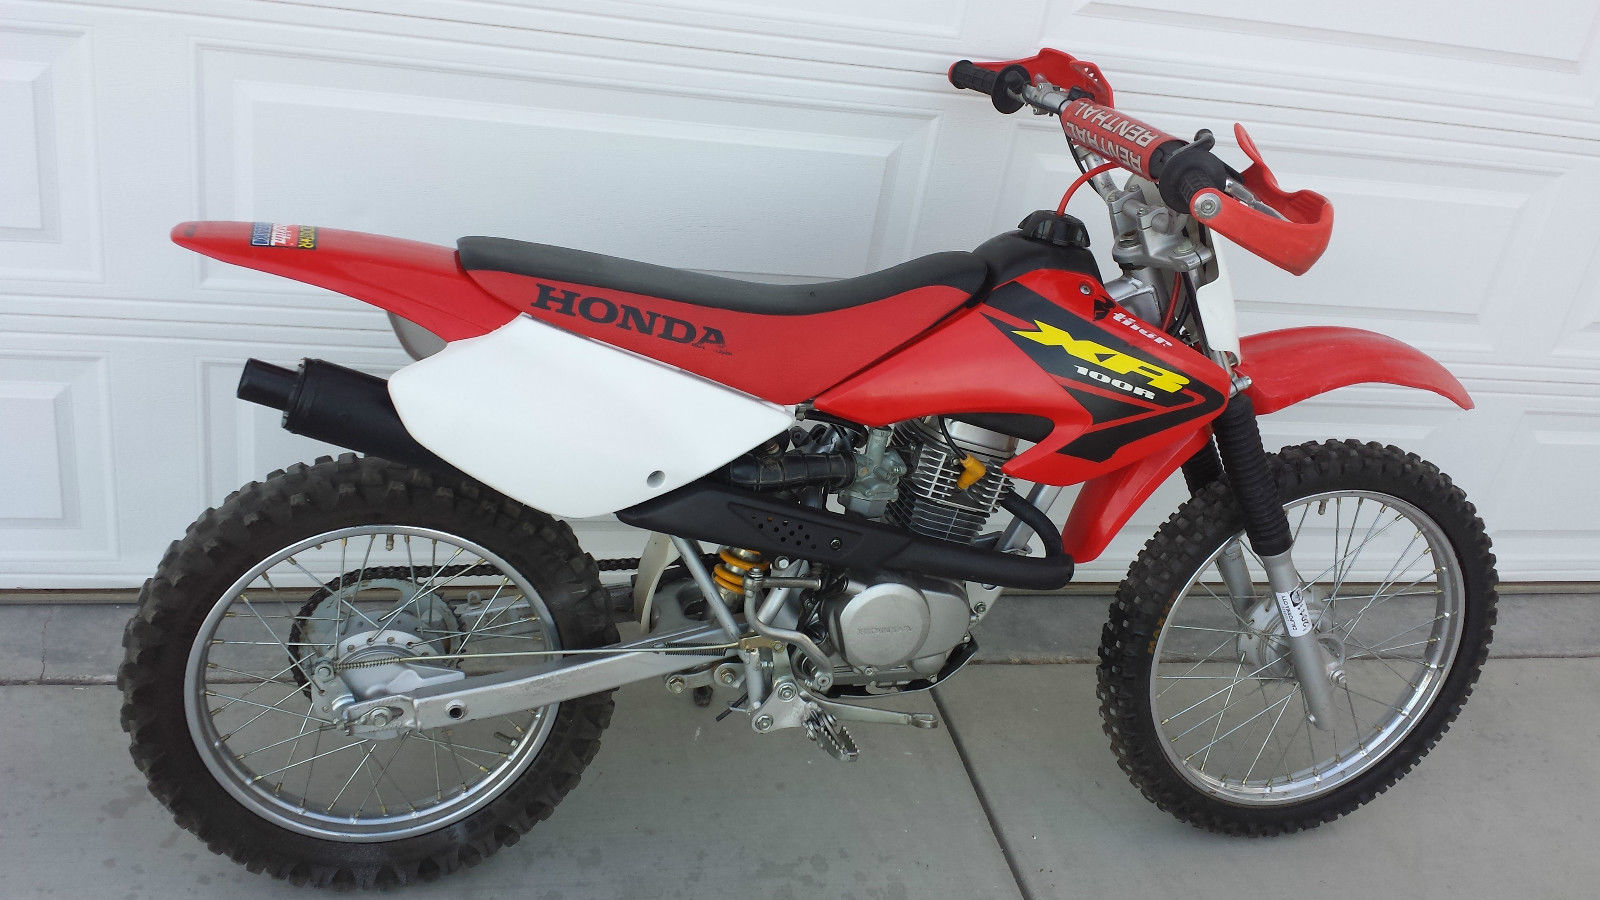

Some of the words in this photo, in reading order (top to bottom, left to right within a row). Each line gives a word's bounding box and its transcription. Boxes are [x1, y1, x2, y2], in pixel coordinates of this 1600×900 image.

[1066, 122, 1143, 174] RENTHAL
[1074, 102, 1159, 148] RENTHAL
[531, 283, 726, 348] HONDA
[1011, 319, 1190, 393] XR
[1073, 365, 1155, 400] 100R
